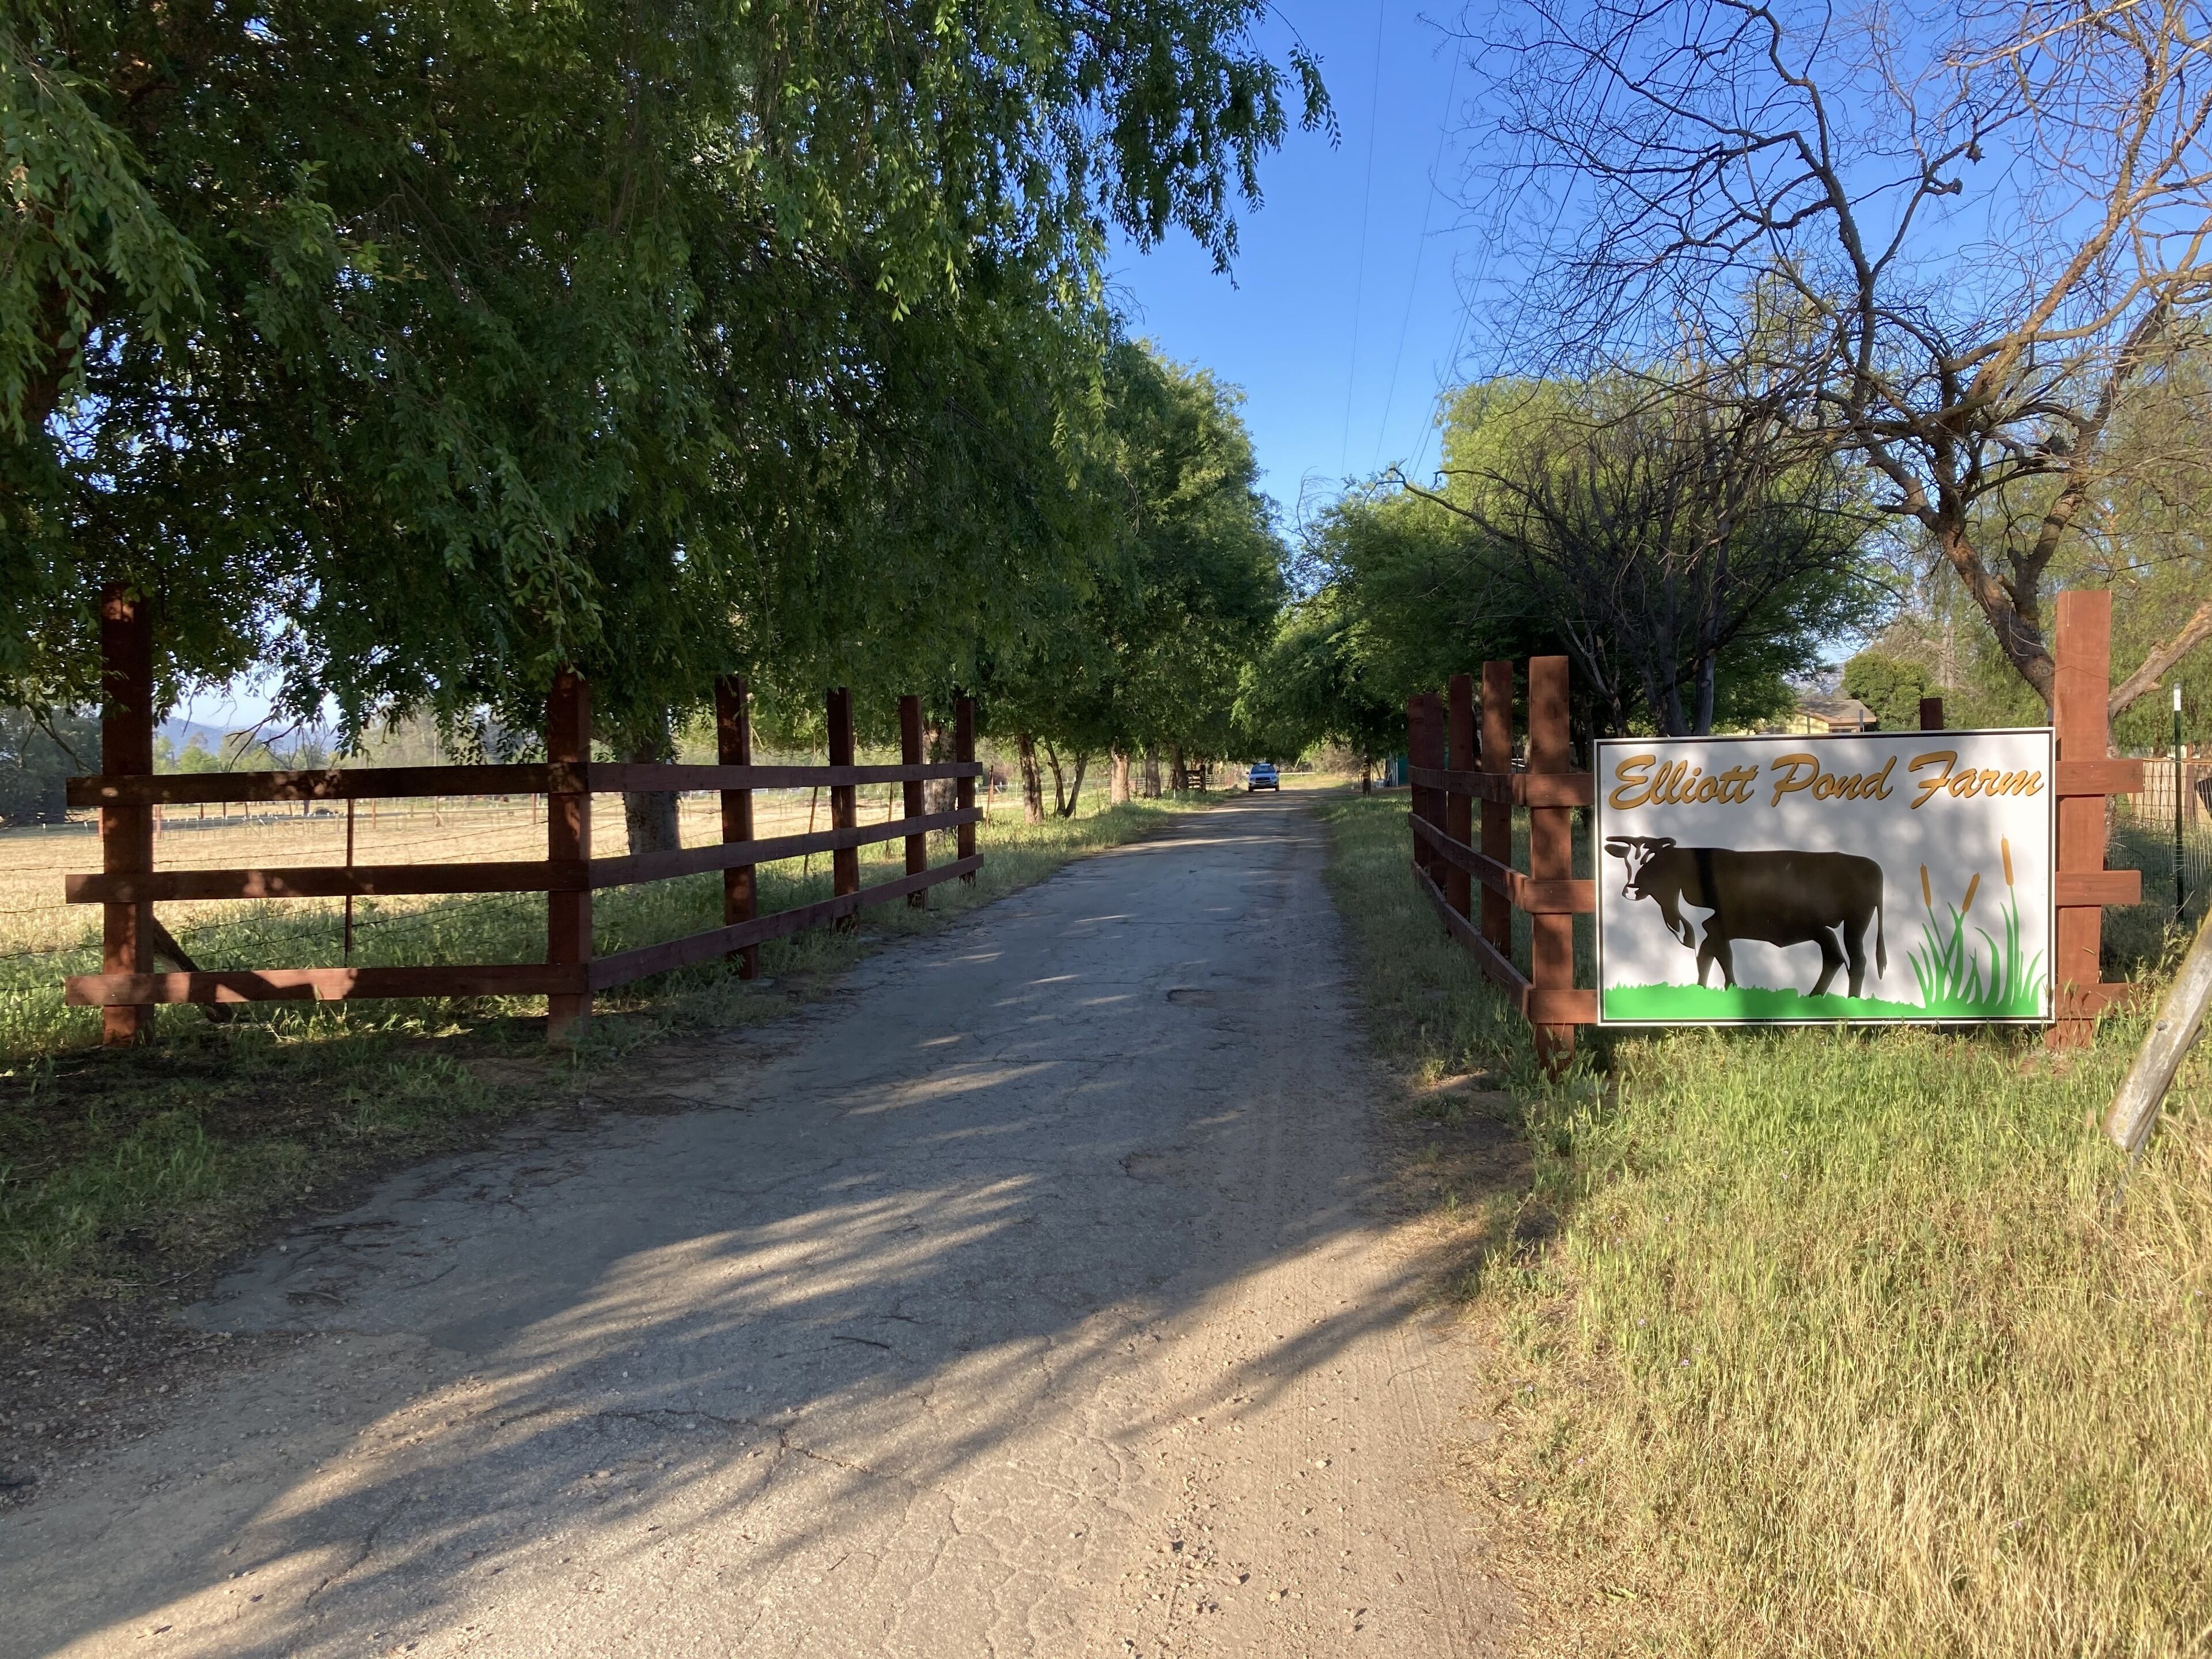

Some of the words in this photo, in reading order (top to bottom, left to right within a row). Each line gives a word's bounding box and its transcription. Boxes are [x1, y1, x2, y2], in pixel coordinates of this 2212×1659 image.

[1608, 754, 1759, 809] Elliott
[1770, 753, 1898, 808] Pond
[1908, 751, 2044, 809] Farm
